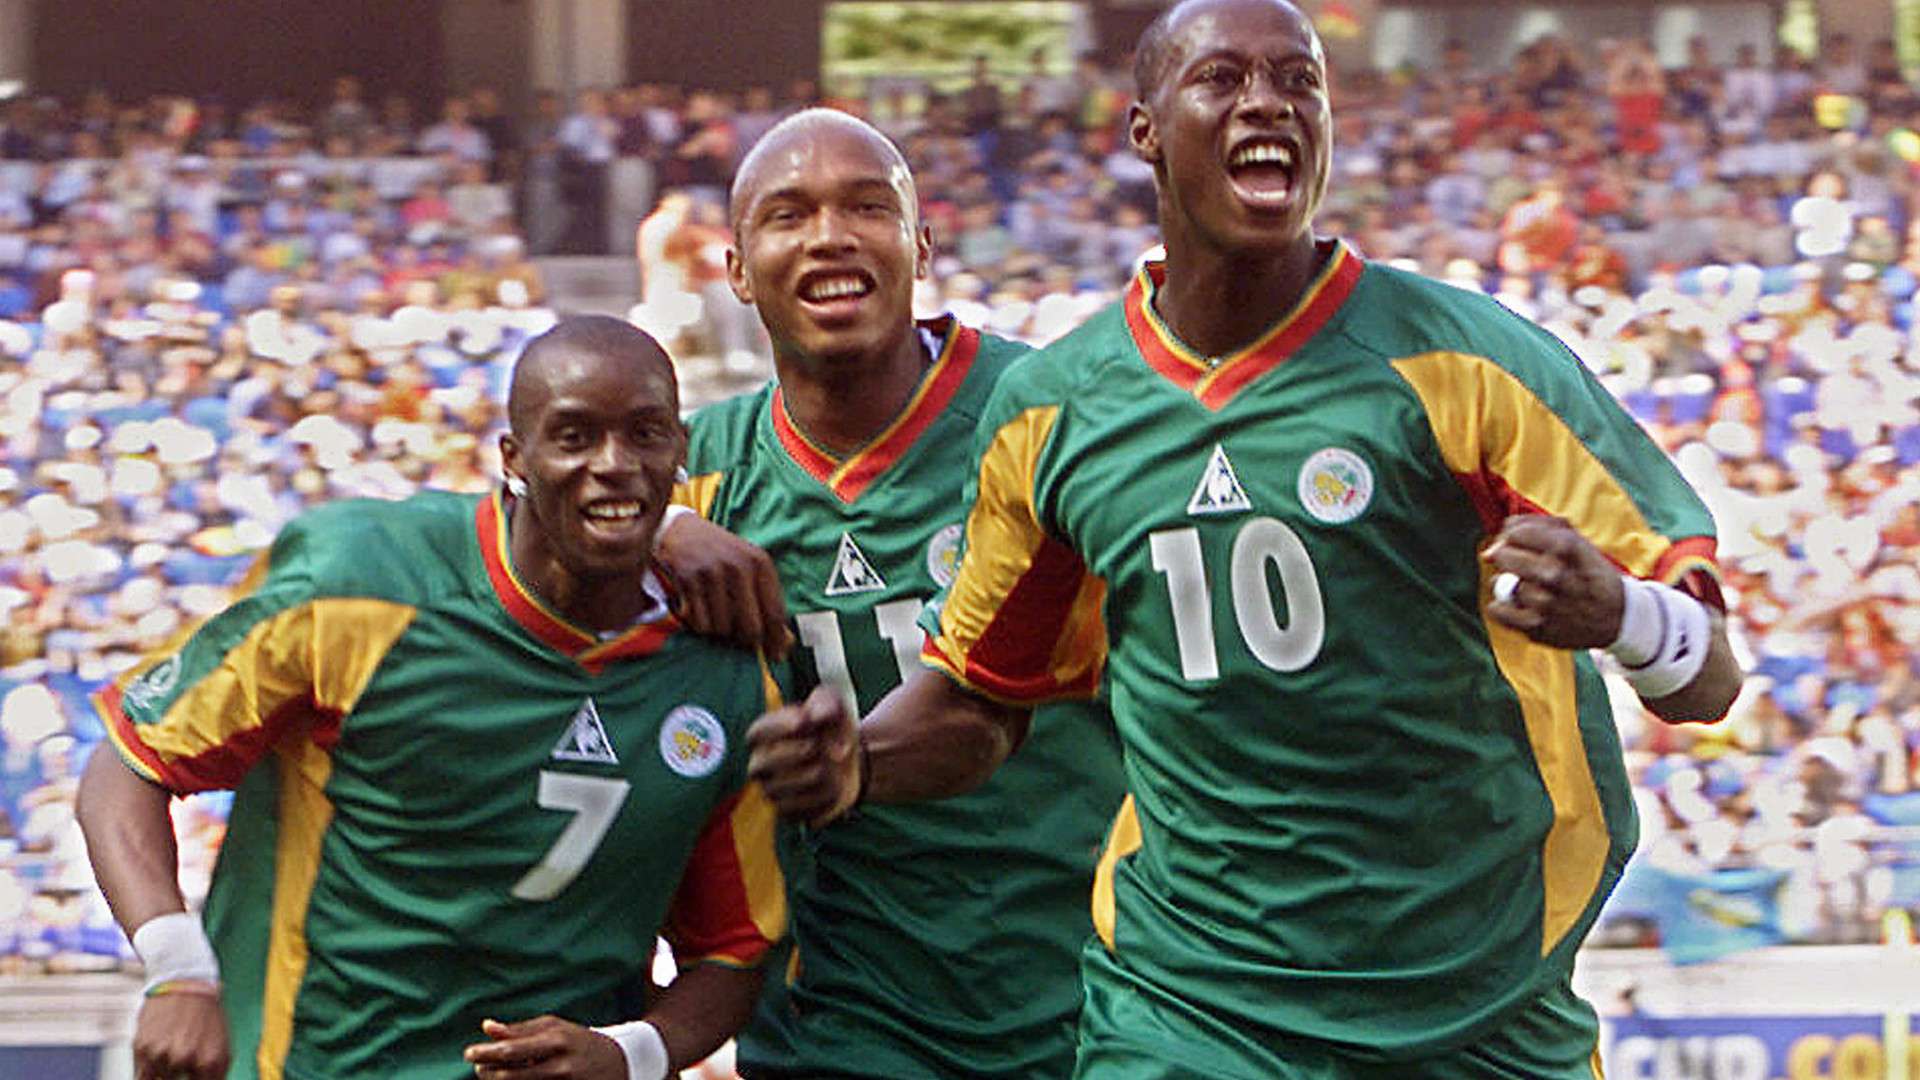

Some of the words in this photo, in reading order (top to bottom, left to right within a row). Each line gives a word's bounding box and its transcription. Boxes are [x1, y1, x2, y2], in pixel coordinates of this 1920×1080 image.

[795, 598, 926, 728] 11
[1150, 516, 1325, 681] 10
[511, 769, 632, 900] 7
